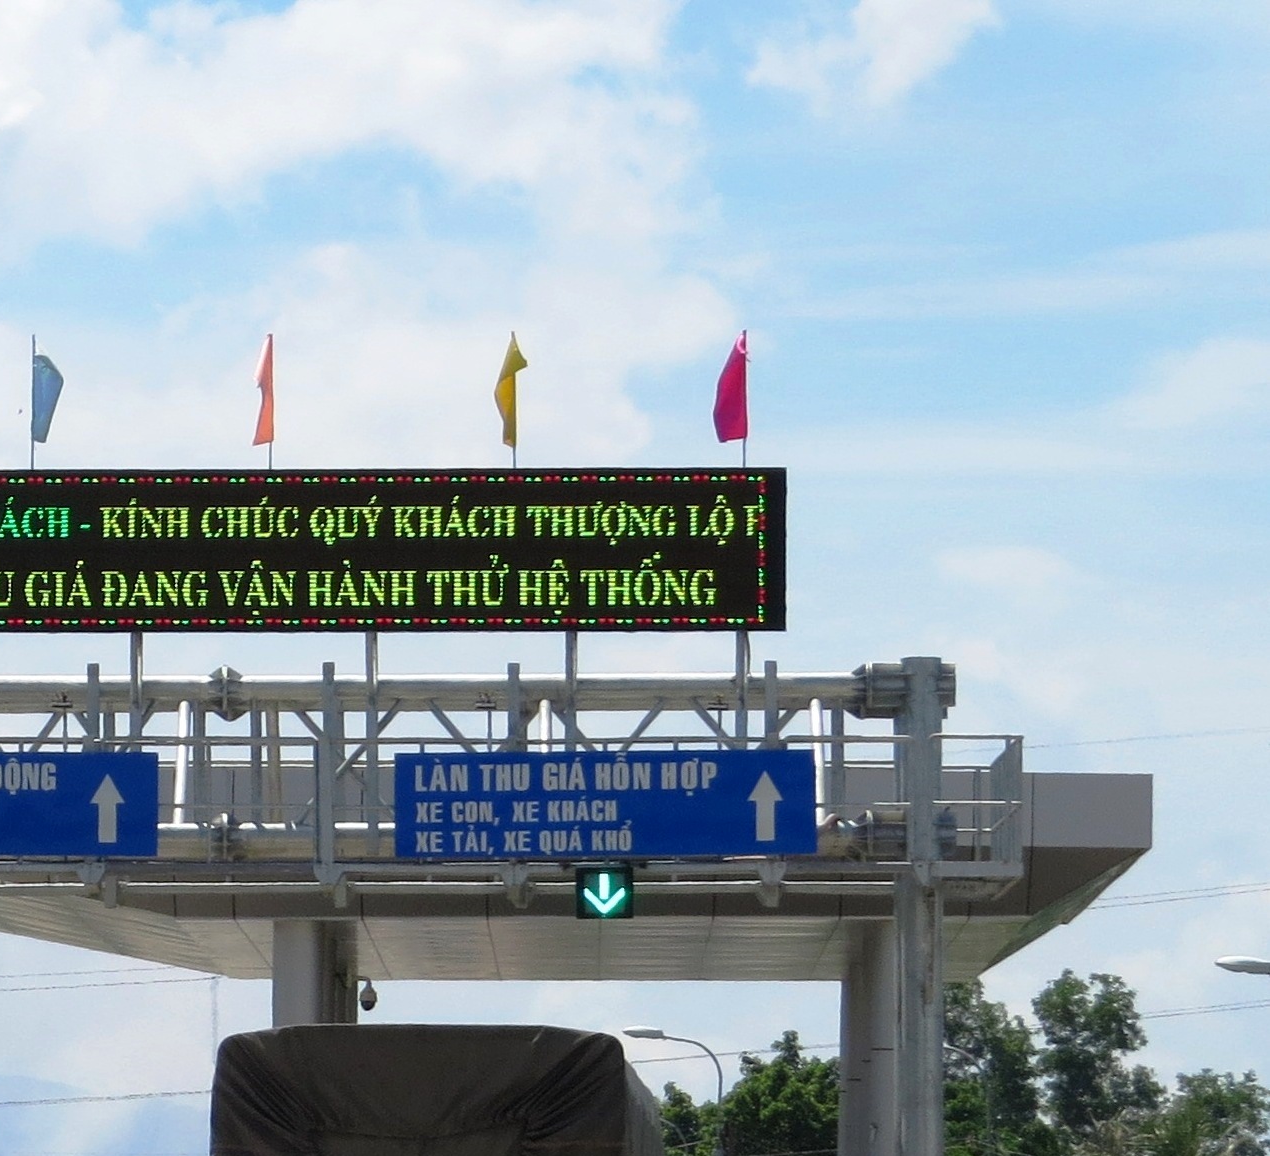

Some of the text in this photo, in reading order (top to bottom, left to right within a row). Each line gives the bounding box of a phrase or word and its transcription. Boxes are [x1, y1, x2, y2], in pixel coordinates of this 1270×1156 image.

[99, 497, 190, 538] KÍNH
[200, 496, 299, 538] CHÚC
[309, 495, 383, 545] QUÝ
[390, 495, 516, 537] KHÁCH
[526, 500, 676, 545] THƯỢNG
[685, 494, 735, 546] LỘ
[24, 560, 92, 607] GIÁ
[101, 570, 209, 607] ĐANG
[217, 560, 297, 616] VẬN
[307, 559, 417, 606] HÀNH
[426, 554, 509, 606] THỬ
[517, 558, 570, 616] HỆ
[579, 551, 717, 606] THỐNG
[414, 751, 717, 796] LÀN THU GIÁ HỖN HỢP
[416, 795, 617, 825] XE CON, XE KHÁCH
[416, 820, 633, 854] XE TẢI, XE QUÁ KHỔ
